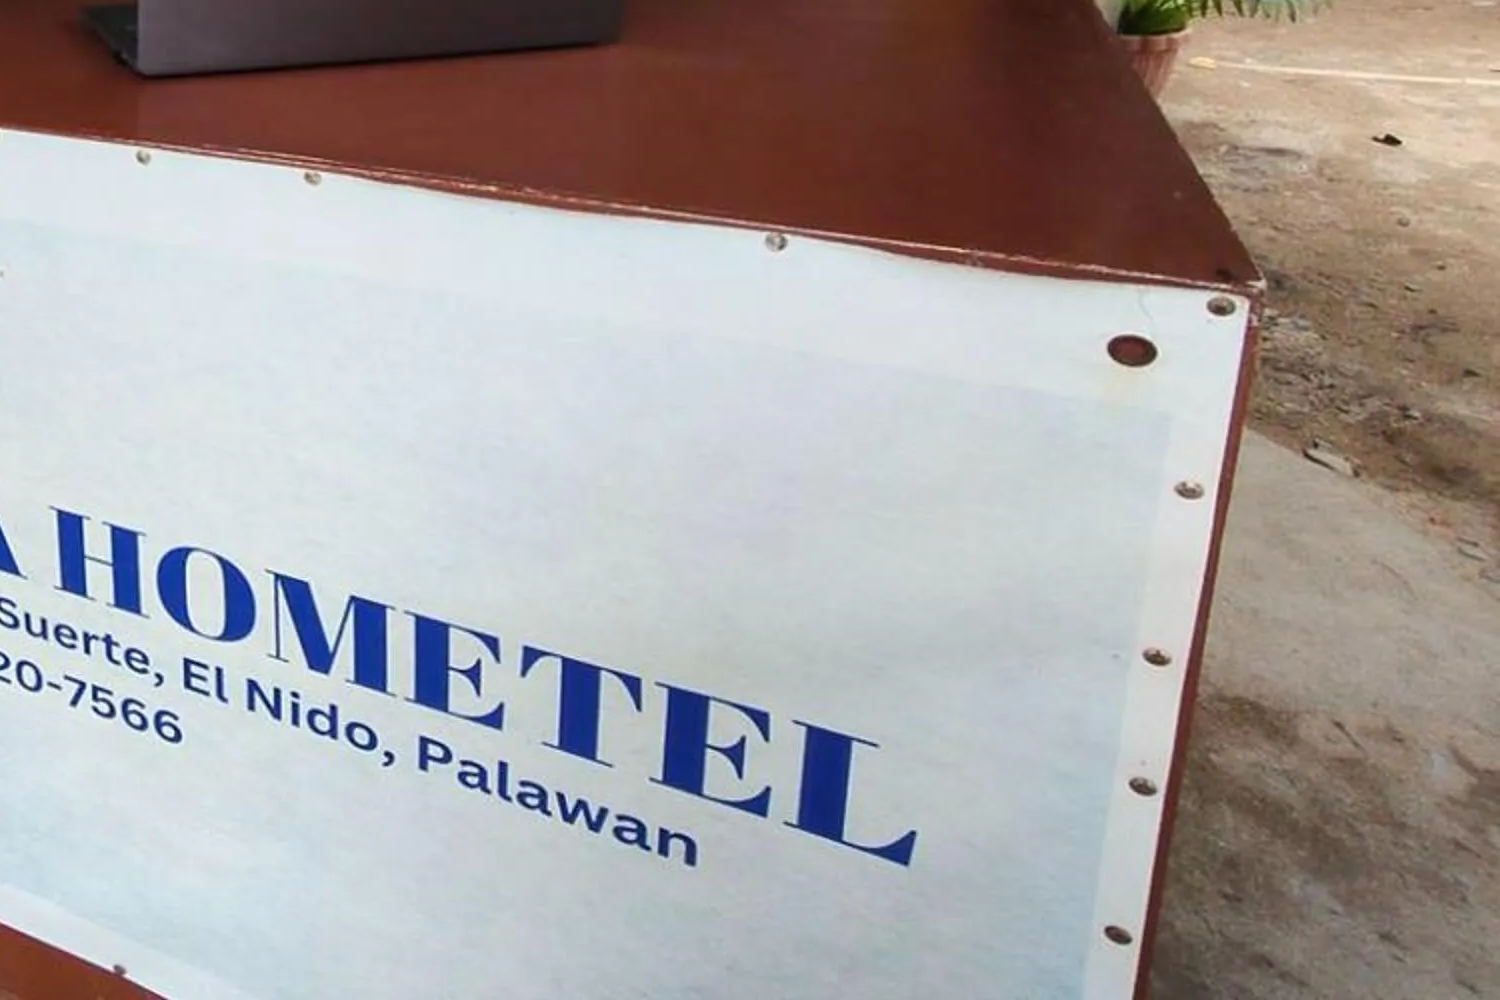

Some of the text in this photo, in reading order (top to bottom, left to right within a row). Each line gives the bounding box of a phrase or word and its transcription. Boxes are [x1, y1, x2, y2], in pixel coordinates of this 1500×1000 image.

[48, 506, 919, 866] HOMETEL
[183, 657, 229, 704] El
[245, 678, 396, 768] Nido,
[417, 736, 698, 867] Palawan
